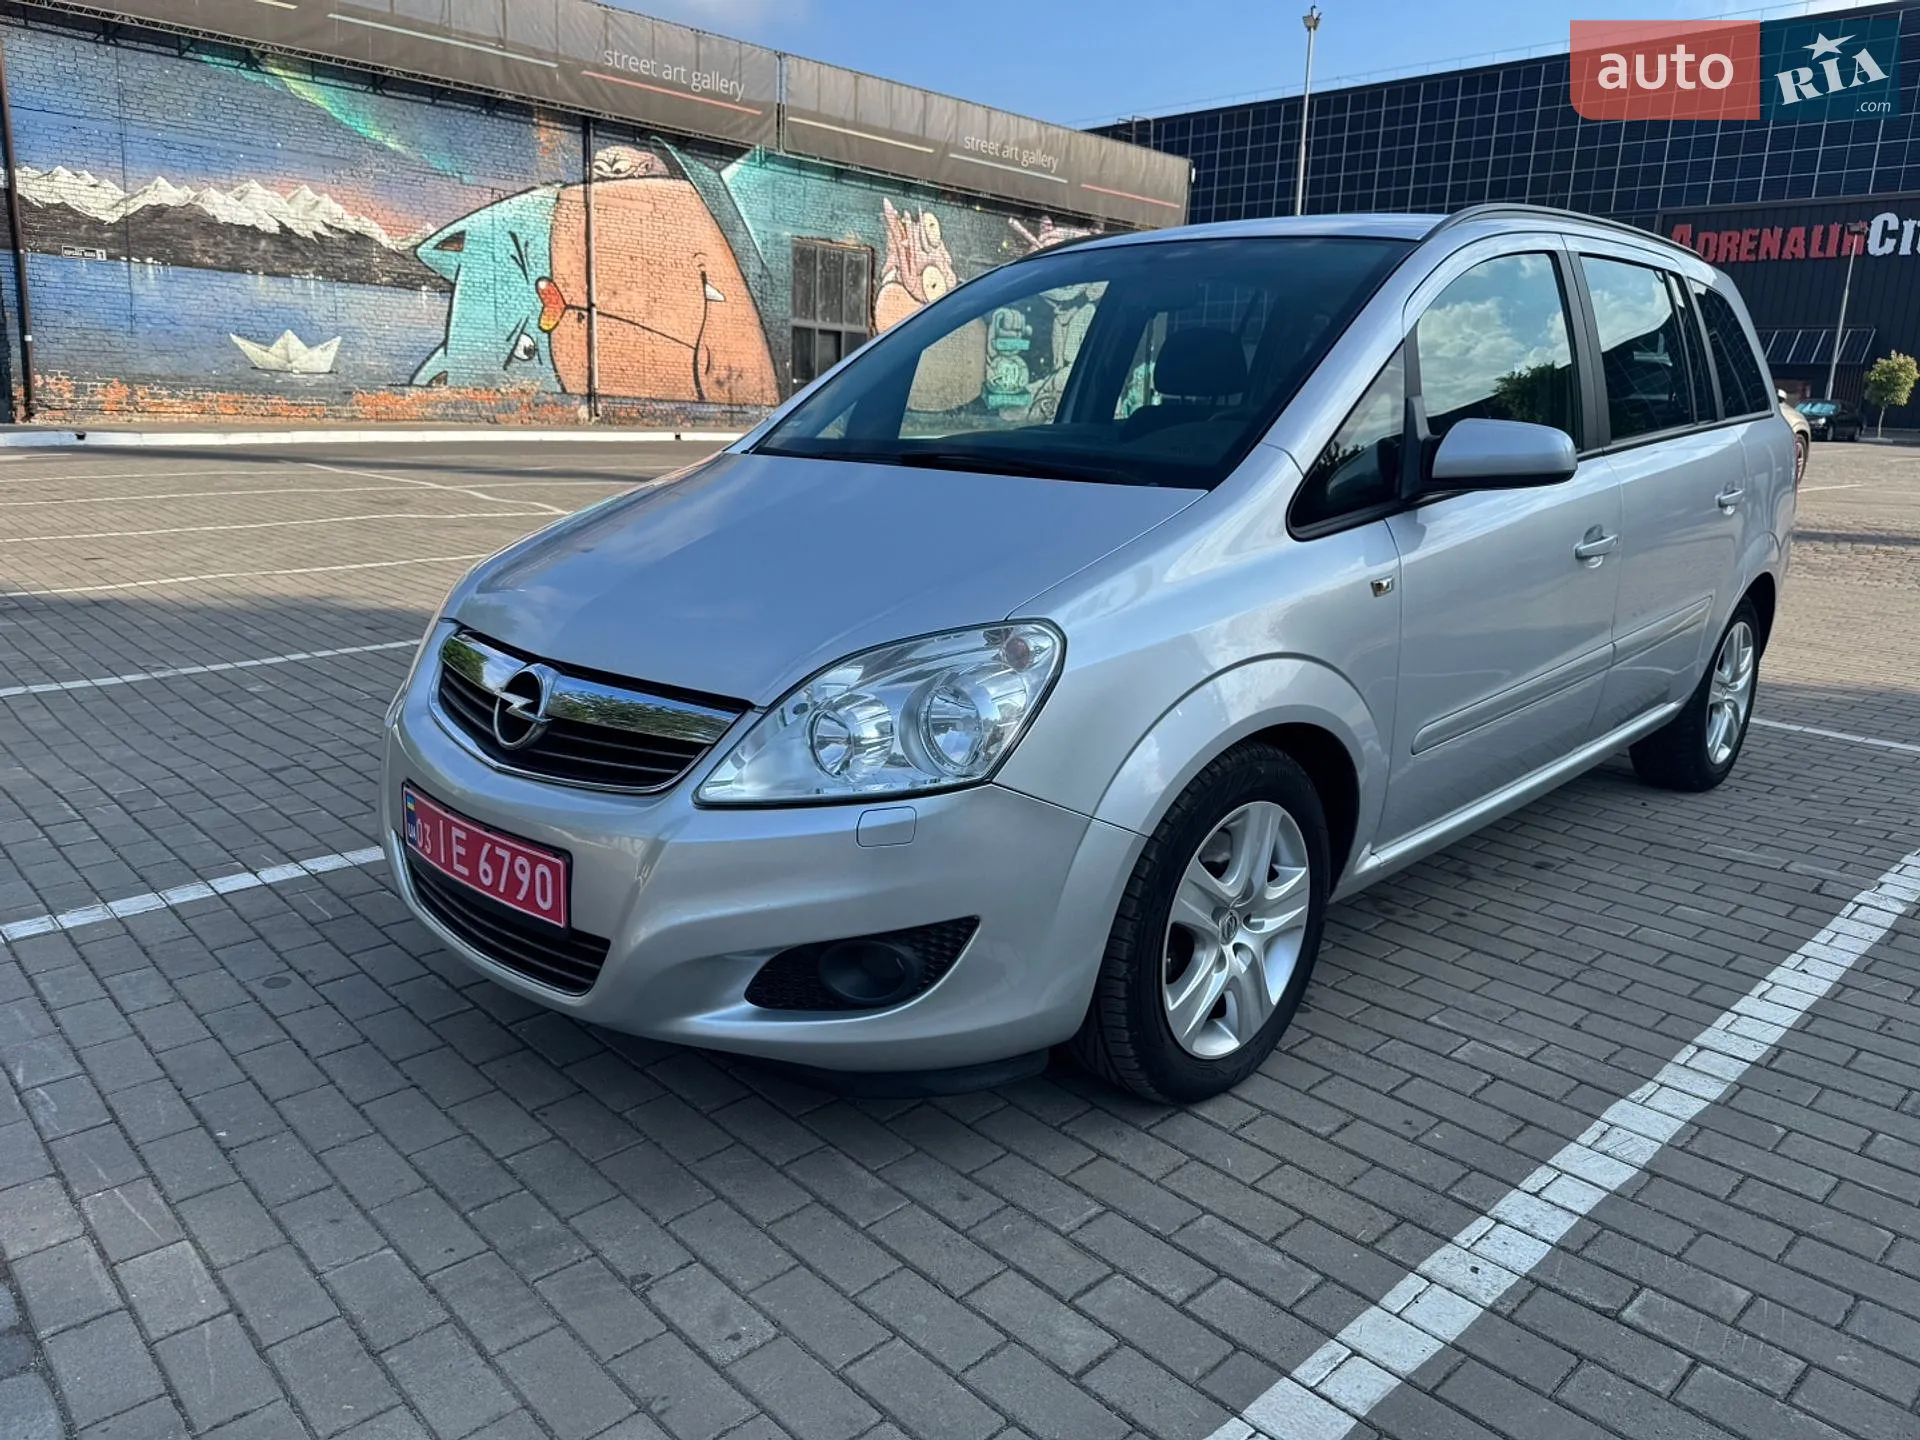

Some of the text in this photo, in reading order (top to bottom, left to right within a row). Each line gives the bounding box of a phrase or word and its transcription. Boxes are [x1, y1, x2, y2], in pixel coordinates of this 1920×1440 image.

[603, 49, 745, 102] street art gallery
[964, 136, 1059, 174] street art gallery
